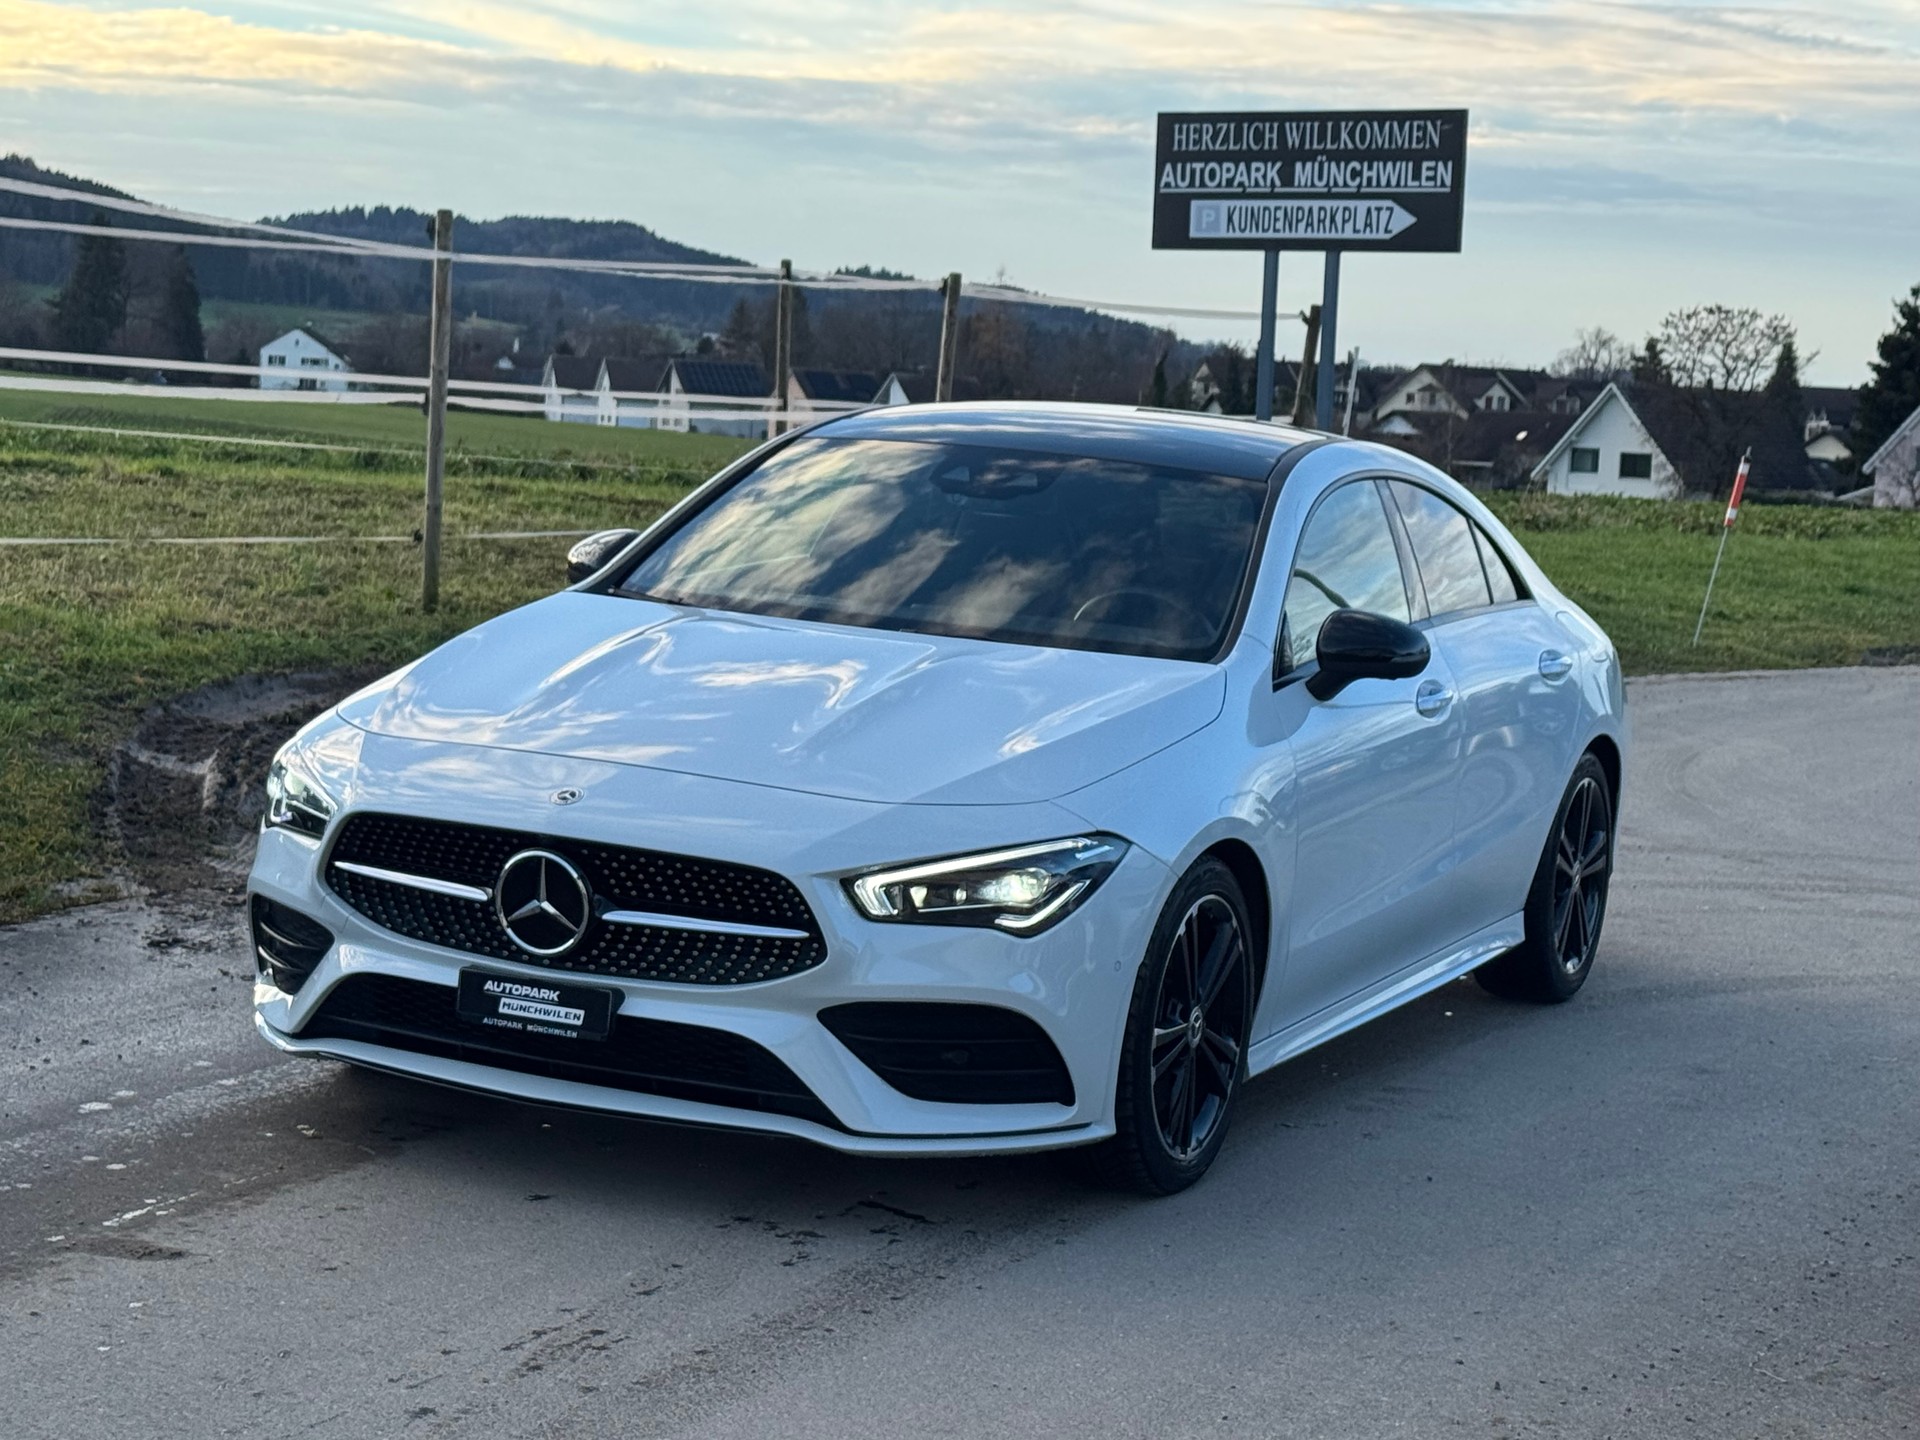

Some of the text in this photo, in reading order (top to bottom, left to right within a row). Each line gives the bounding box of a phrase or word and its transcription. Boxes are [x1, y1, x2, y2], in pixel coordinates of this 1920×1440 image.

[1172, 120, 1442, 151] HERZLICH WILLKOMMEN
[1160, 155, 1452, 188] AUTOPARK MÜNCHWILEN
[1226, 205, 1395, 234] KUNDENPARKPLATZ
[483, 980, 561, 1002] AUTOPARK
[482, 1017, 523, 1031] AUTOPARK
